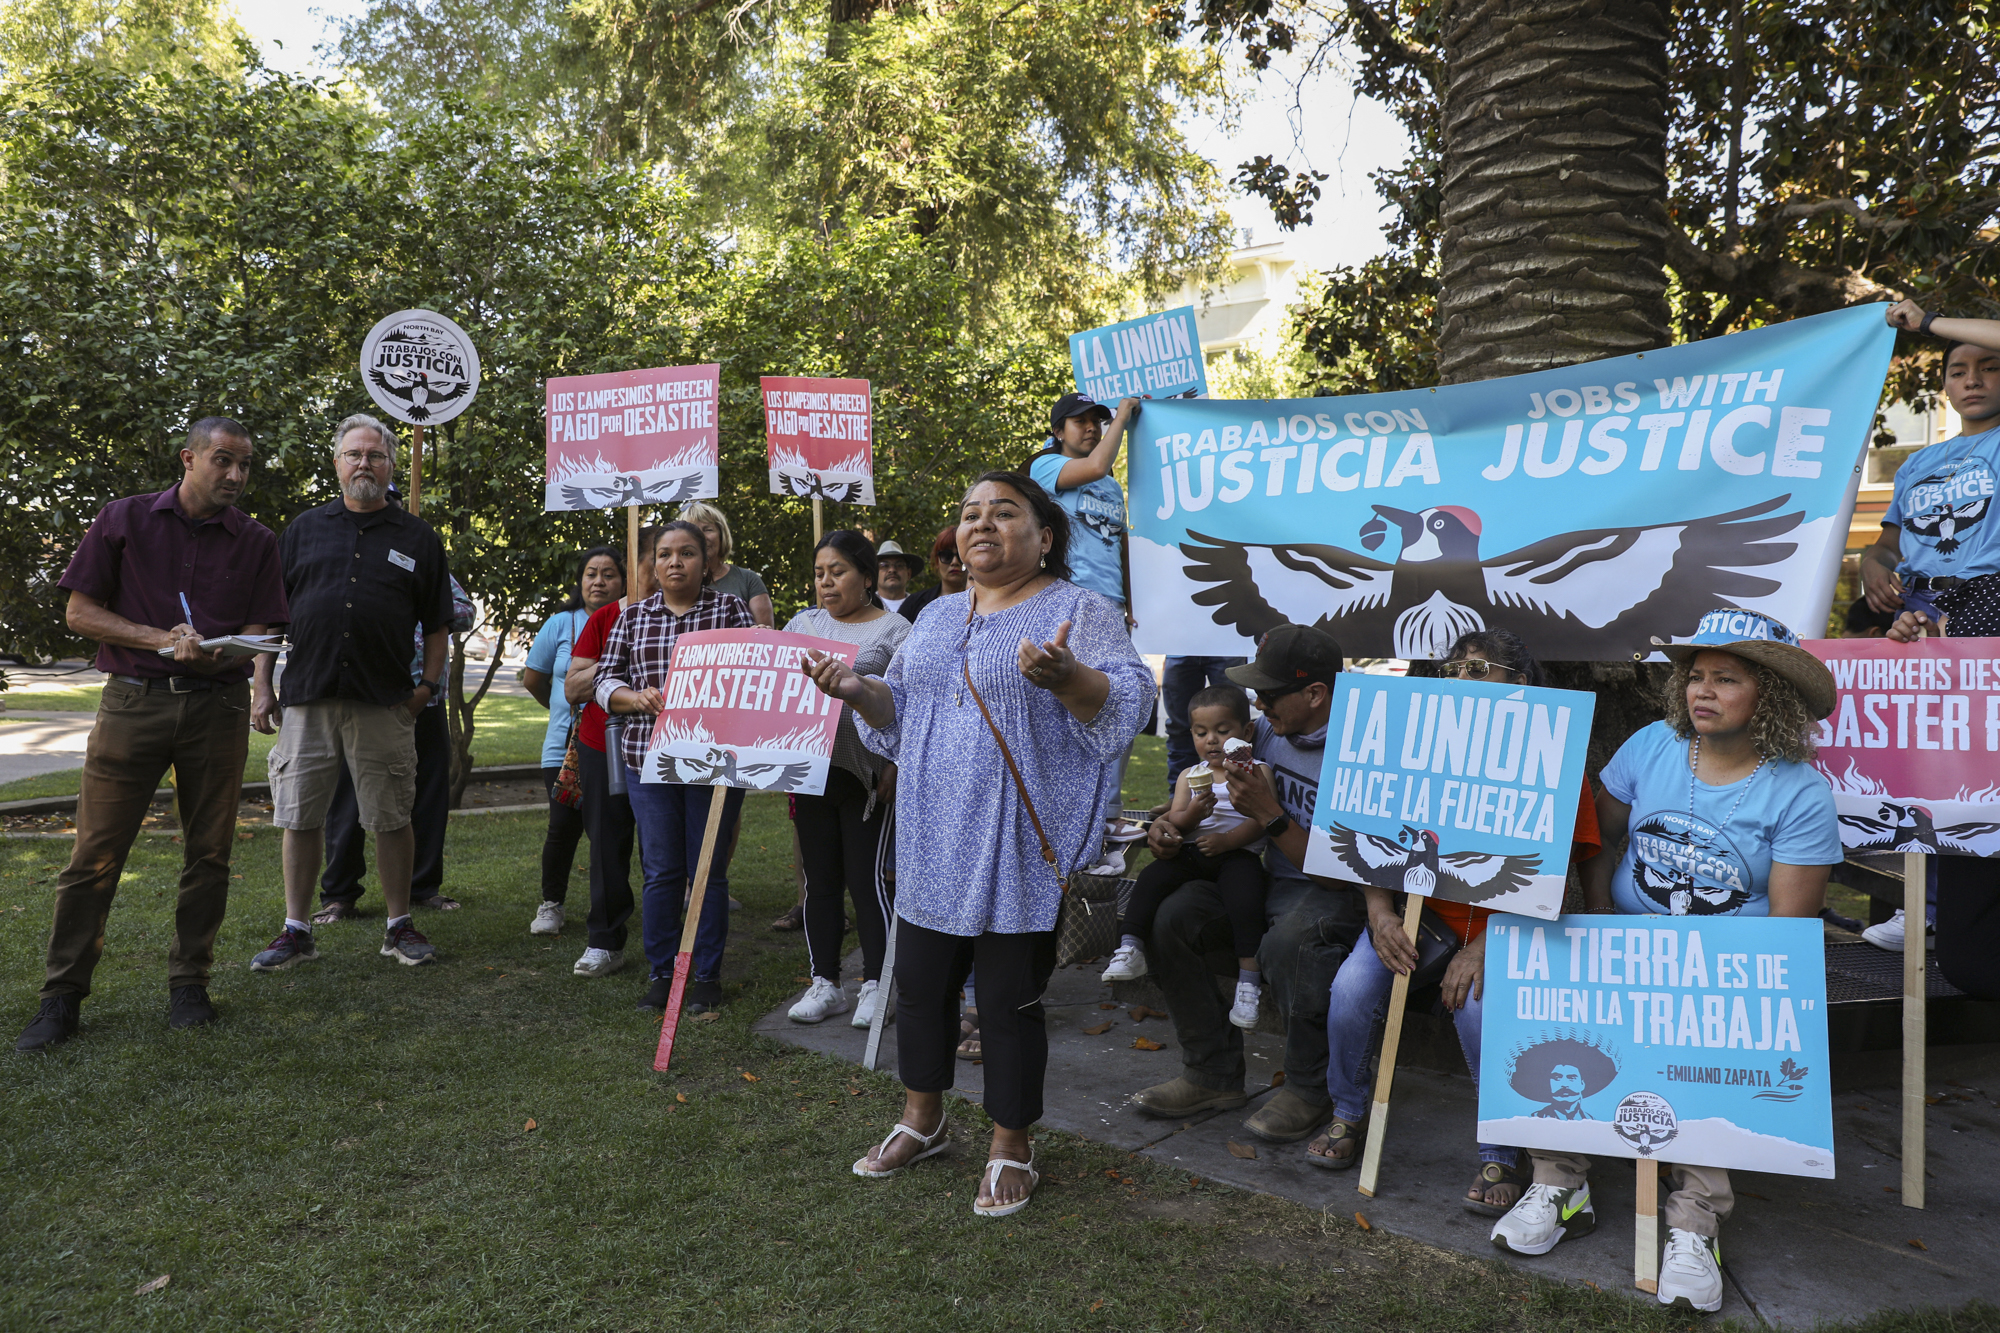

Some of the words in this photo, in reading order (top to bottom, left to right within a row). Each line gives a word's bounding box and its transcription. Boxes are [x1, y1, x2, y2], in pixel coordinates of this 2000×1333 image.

[430, 327, 444, 335] BAY
[1078, 336, 1111, 379] LA
[1111, 313, 1192, 371] UNIÓN
[375, 353, 466, 381] JUSTICIA
[382, 345, 437, 357] TRABAJOS
[439, 351, 461, 365] CON
[552, 392, 575, 412] LOS
[577, 384, 653, 411] CAMPESINOS
[656, 379, 713, 402] MERECEN
[1085, 374, 1124, 402] HACE
[1124, 370, 1144, 395] LA
[1144, 358, 1199, 391] FUERZA
[1527, 381, 1641, 419] JOBS
[1653, 368, 1785, 409] WITH
[551, 412, 599, 443] PAGO
[601, 414, 622, 434] POR
[624, 400, 714, 437] DESASTRE
[766, 390, 782, 408] LOS
[783, 391, 829, 411] CAMPESINOS
[830, 393, 867, 413] MERECEN
[768, 410, 798, 436] PAGO
[798, 415, 810, 432] POR
[809, 412, 868, 441] DESASTRE
[1155, 413, 1338, 465] TRABAJOS
[1343, 407, 1429, 437] CON
[1481, 404, 1832, 481] JUSTICE
[1156, 431, 1441, 521] JUSTICIA
[1950, 469, 1989, 486] WITH
[1905, 478, 1995, 517] JUSTICE
[674, 642, 773, 669] FARMWORKERS
[664, 667, 778, 711] DISASTER
[1338, 687, 1388, 767] LA
[1400, 688, 1572, 790] UNIÓN
[1276, 775, 1317, 816] ANS
[1330, 766, 1399, 818] HACE
[1400, 774, 1431, 824] LA
[1438, 779, 1555, 843] FUERZA
[1663, 815, 1696, 831] NORTH
[1697, 825, 1716, 837] BAY
[1636, 836, 1704, 862] TRABAJOS
[1707, 856, 1739, 878] CON
[1564, 926, 1710, 988] TIERRA
[1717, 953, 1749, 989] ES
[1756, 954, 1789, 990] DE
[1516, 986, 1589, 1024] QUIEN
[1595, 990, 1623, 1026] LA
[1666, 1064, 1721, 1085] EMILIANO
[1724, 1067, 1772, 1088] ZAPATA
[1616, 1112, 1675, 1128] JUSTICIA
[1620, 1107, 1655, 1115] TRABAJOS
[1655, 1109, 1671, 1118] CON
